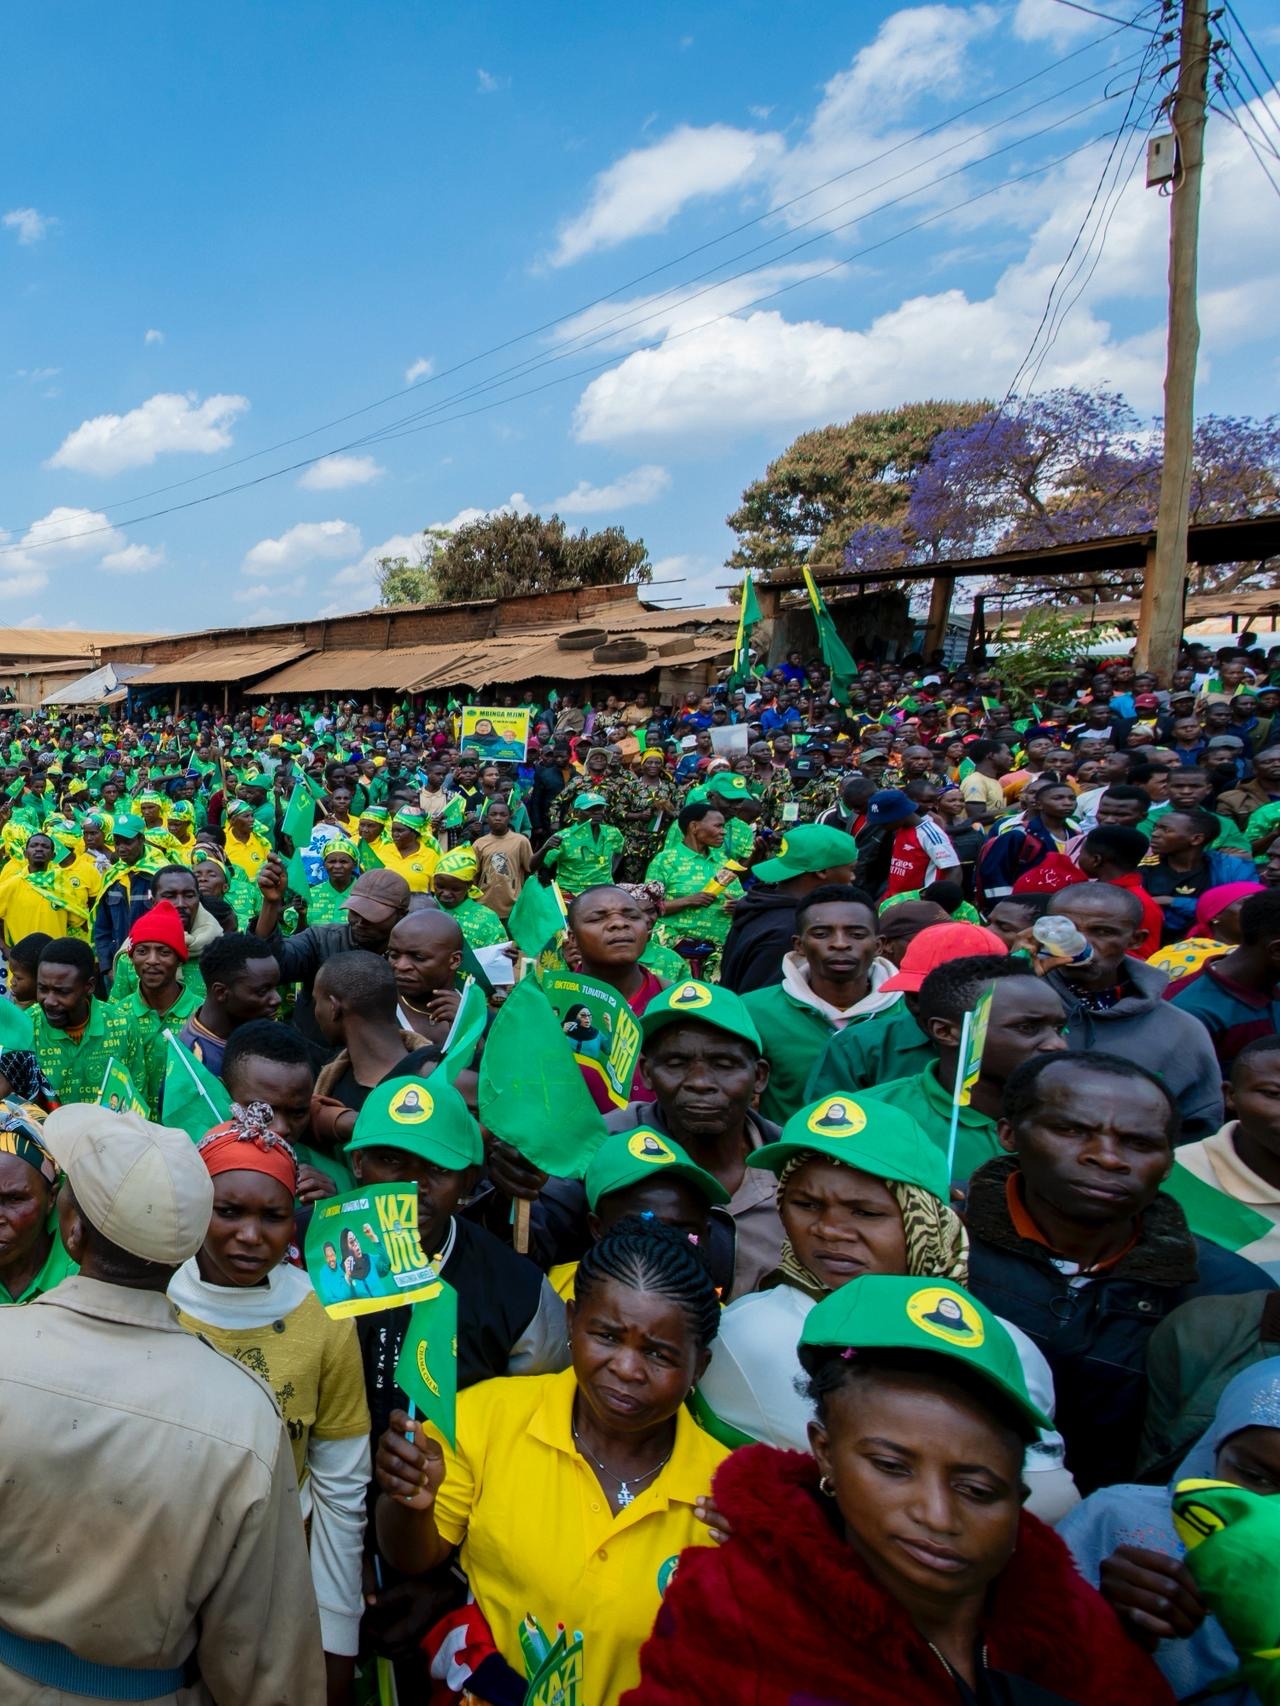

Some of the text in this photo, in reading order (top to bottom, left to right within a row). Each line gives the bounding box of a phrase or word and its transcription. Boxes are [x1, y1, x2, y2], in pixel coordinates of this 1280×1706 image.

[480, 710, 505, 718] MBINGA
[106, 1018, 127, 1028] CCM
[103, 1039, 120, 1048] SSH
[40, 1047, 61, 1056] CCM
[79, 1086, 99, 1094] CCM
